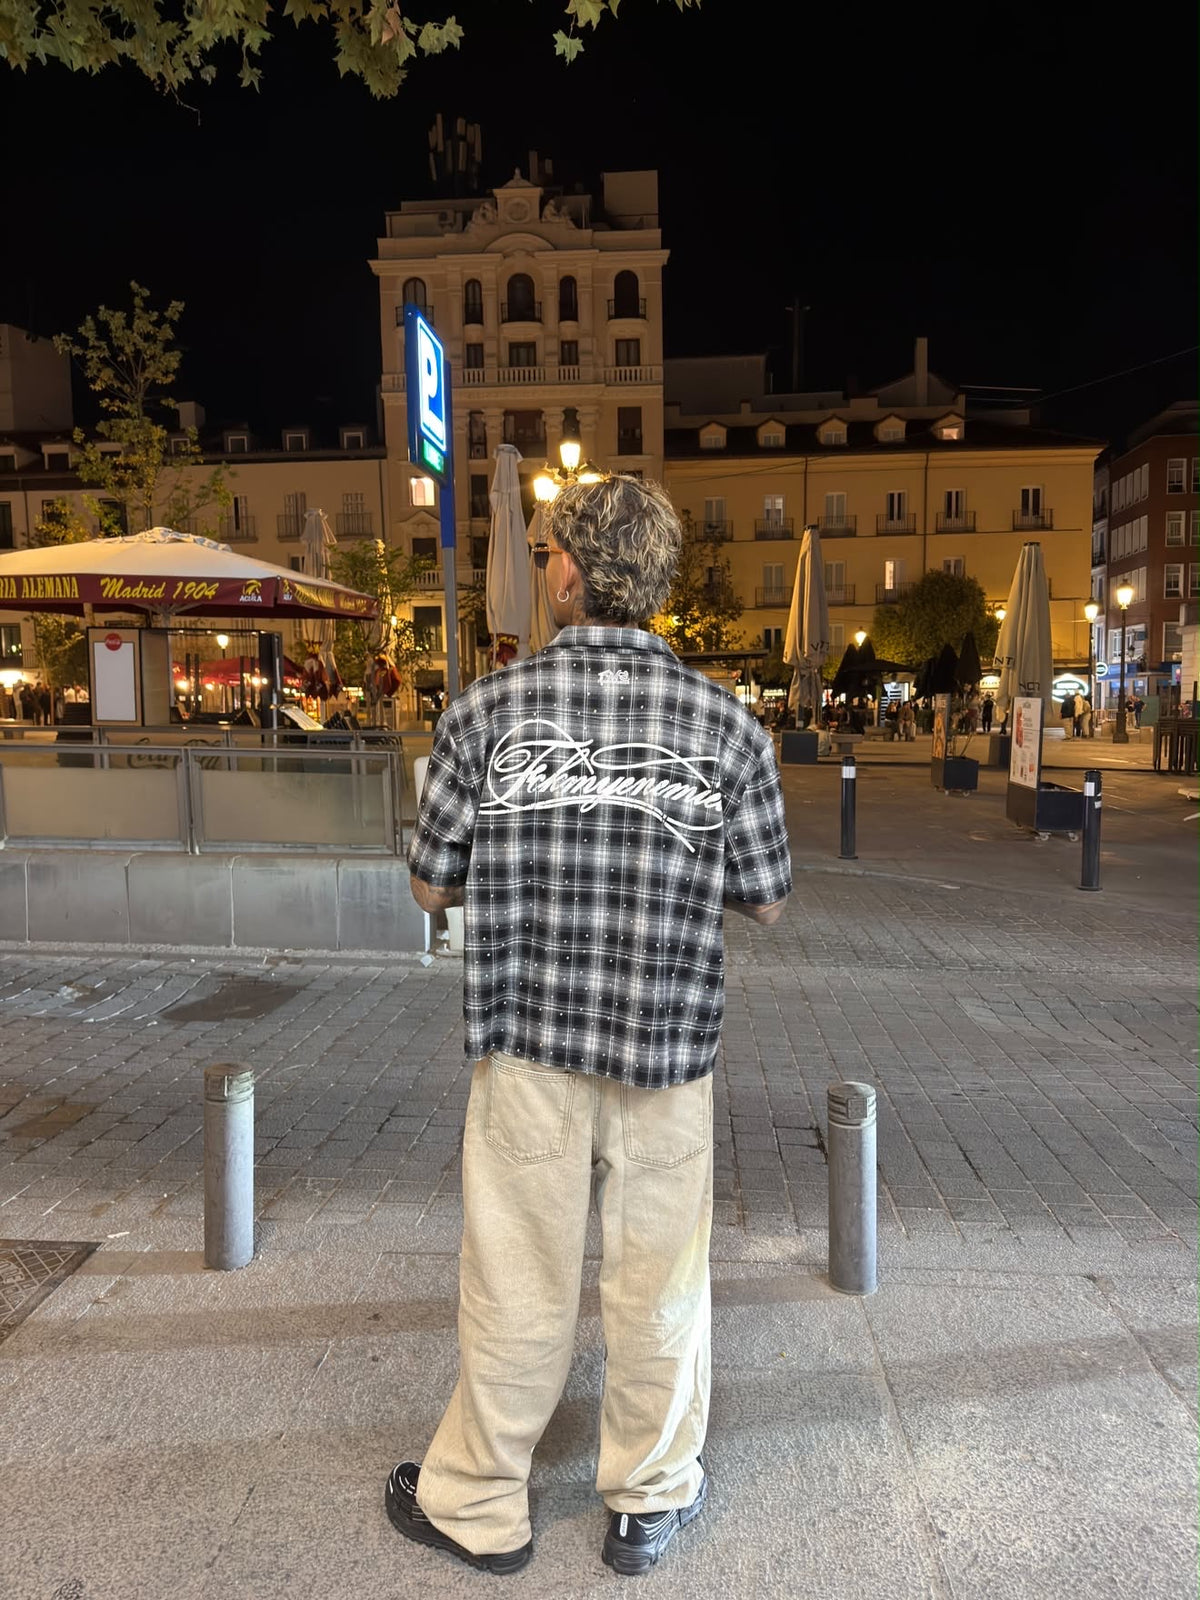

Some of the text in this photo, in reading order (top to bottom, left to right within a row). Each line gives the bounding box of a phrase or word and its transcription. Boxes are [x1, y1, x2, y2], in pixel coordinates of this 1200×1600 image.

[419, 327, 439, 425] P
[21, 576, 79, 599] ALEMANA
[100, 577, 219, 600] Madrid 1904
